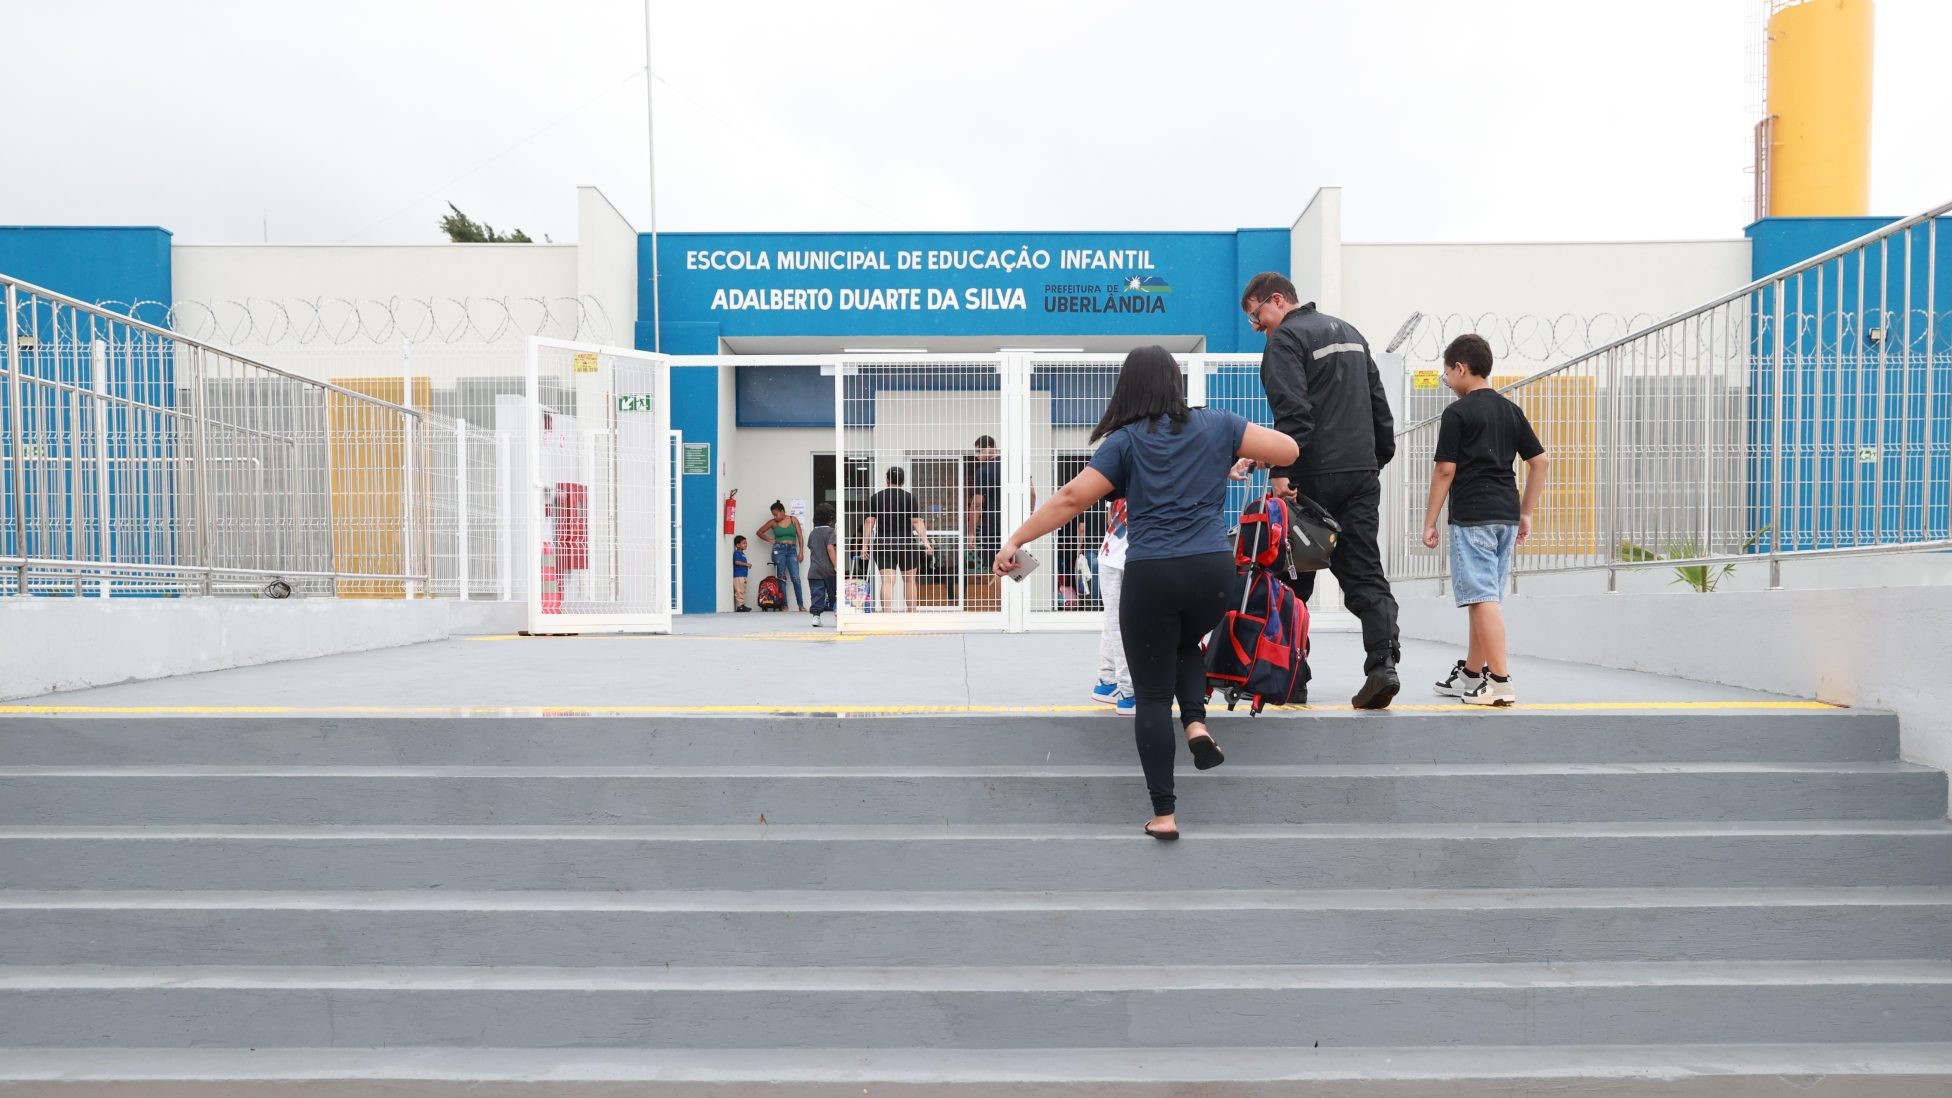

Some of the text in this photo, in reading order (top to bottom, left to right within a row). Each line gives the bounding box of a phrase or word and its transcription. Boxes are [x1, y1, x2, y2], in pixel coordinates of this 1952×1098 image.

[686, 244, 1155, 273] ESCOLA MUNICIPAL DE EDUCAÇÃO INFANTIL
[710, 287, 1027, 311] ADALBERTO DUARTE DA SILVA
[1044, 284, 1119, 294] PREFEITURA DE
[1044, 293, 1167, 314] UBERLÂNDIA
